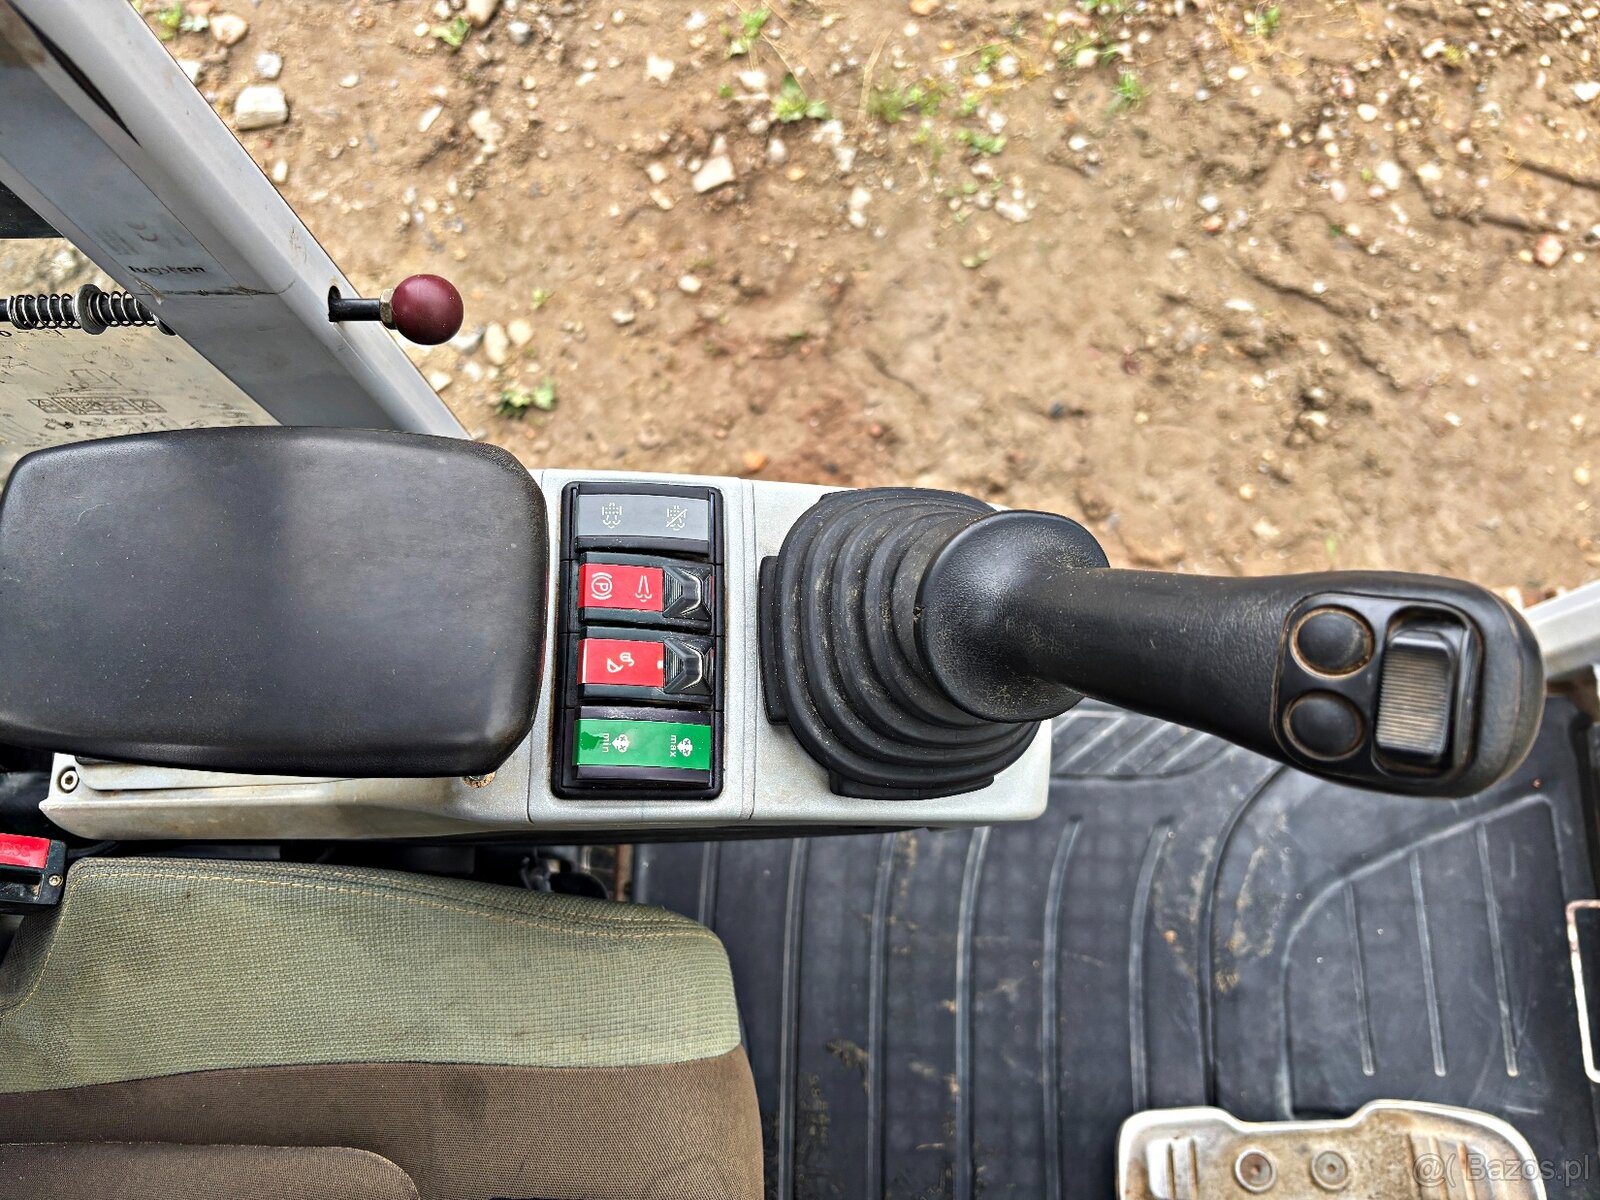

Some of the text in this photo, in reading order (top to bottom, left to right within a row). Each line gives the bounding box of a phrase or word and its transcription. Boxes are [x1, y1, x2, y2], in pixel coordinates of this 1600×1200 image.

[601, 732, 610, 753] min
[669, 734, 677, 758] max
[0, 840, 31, 858] ESS
